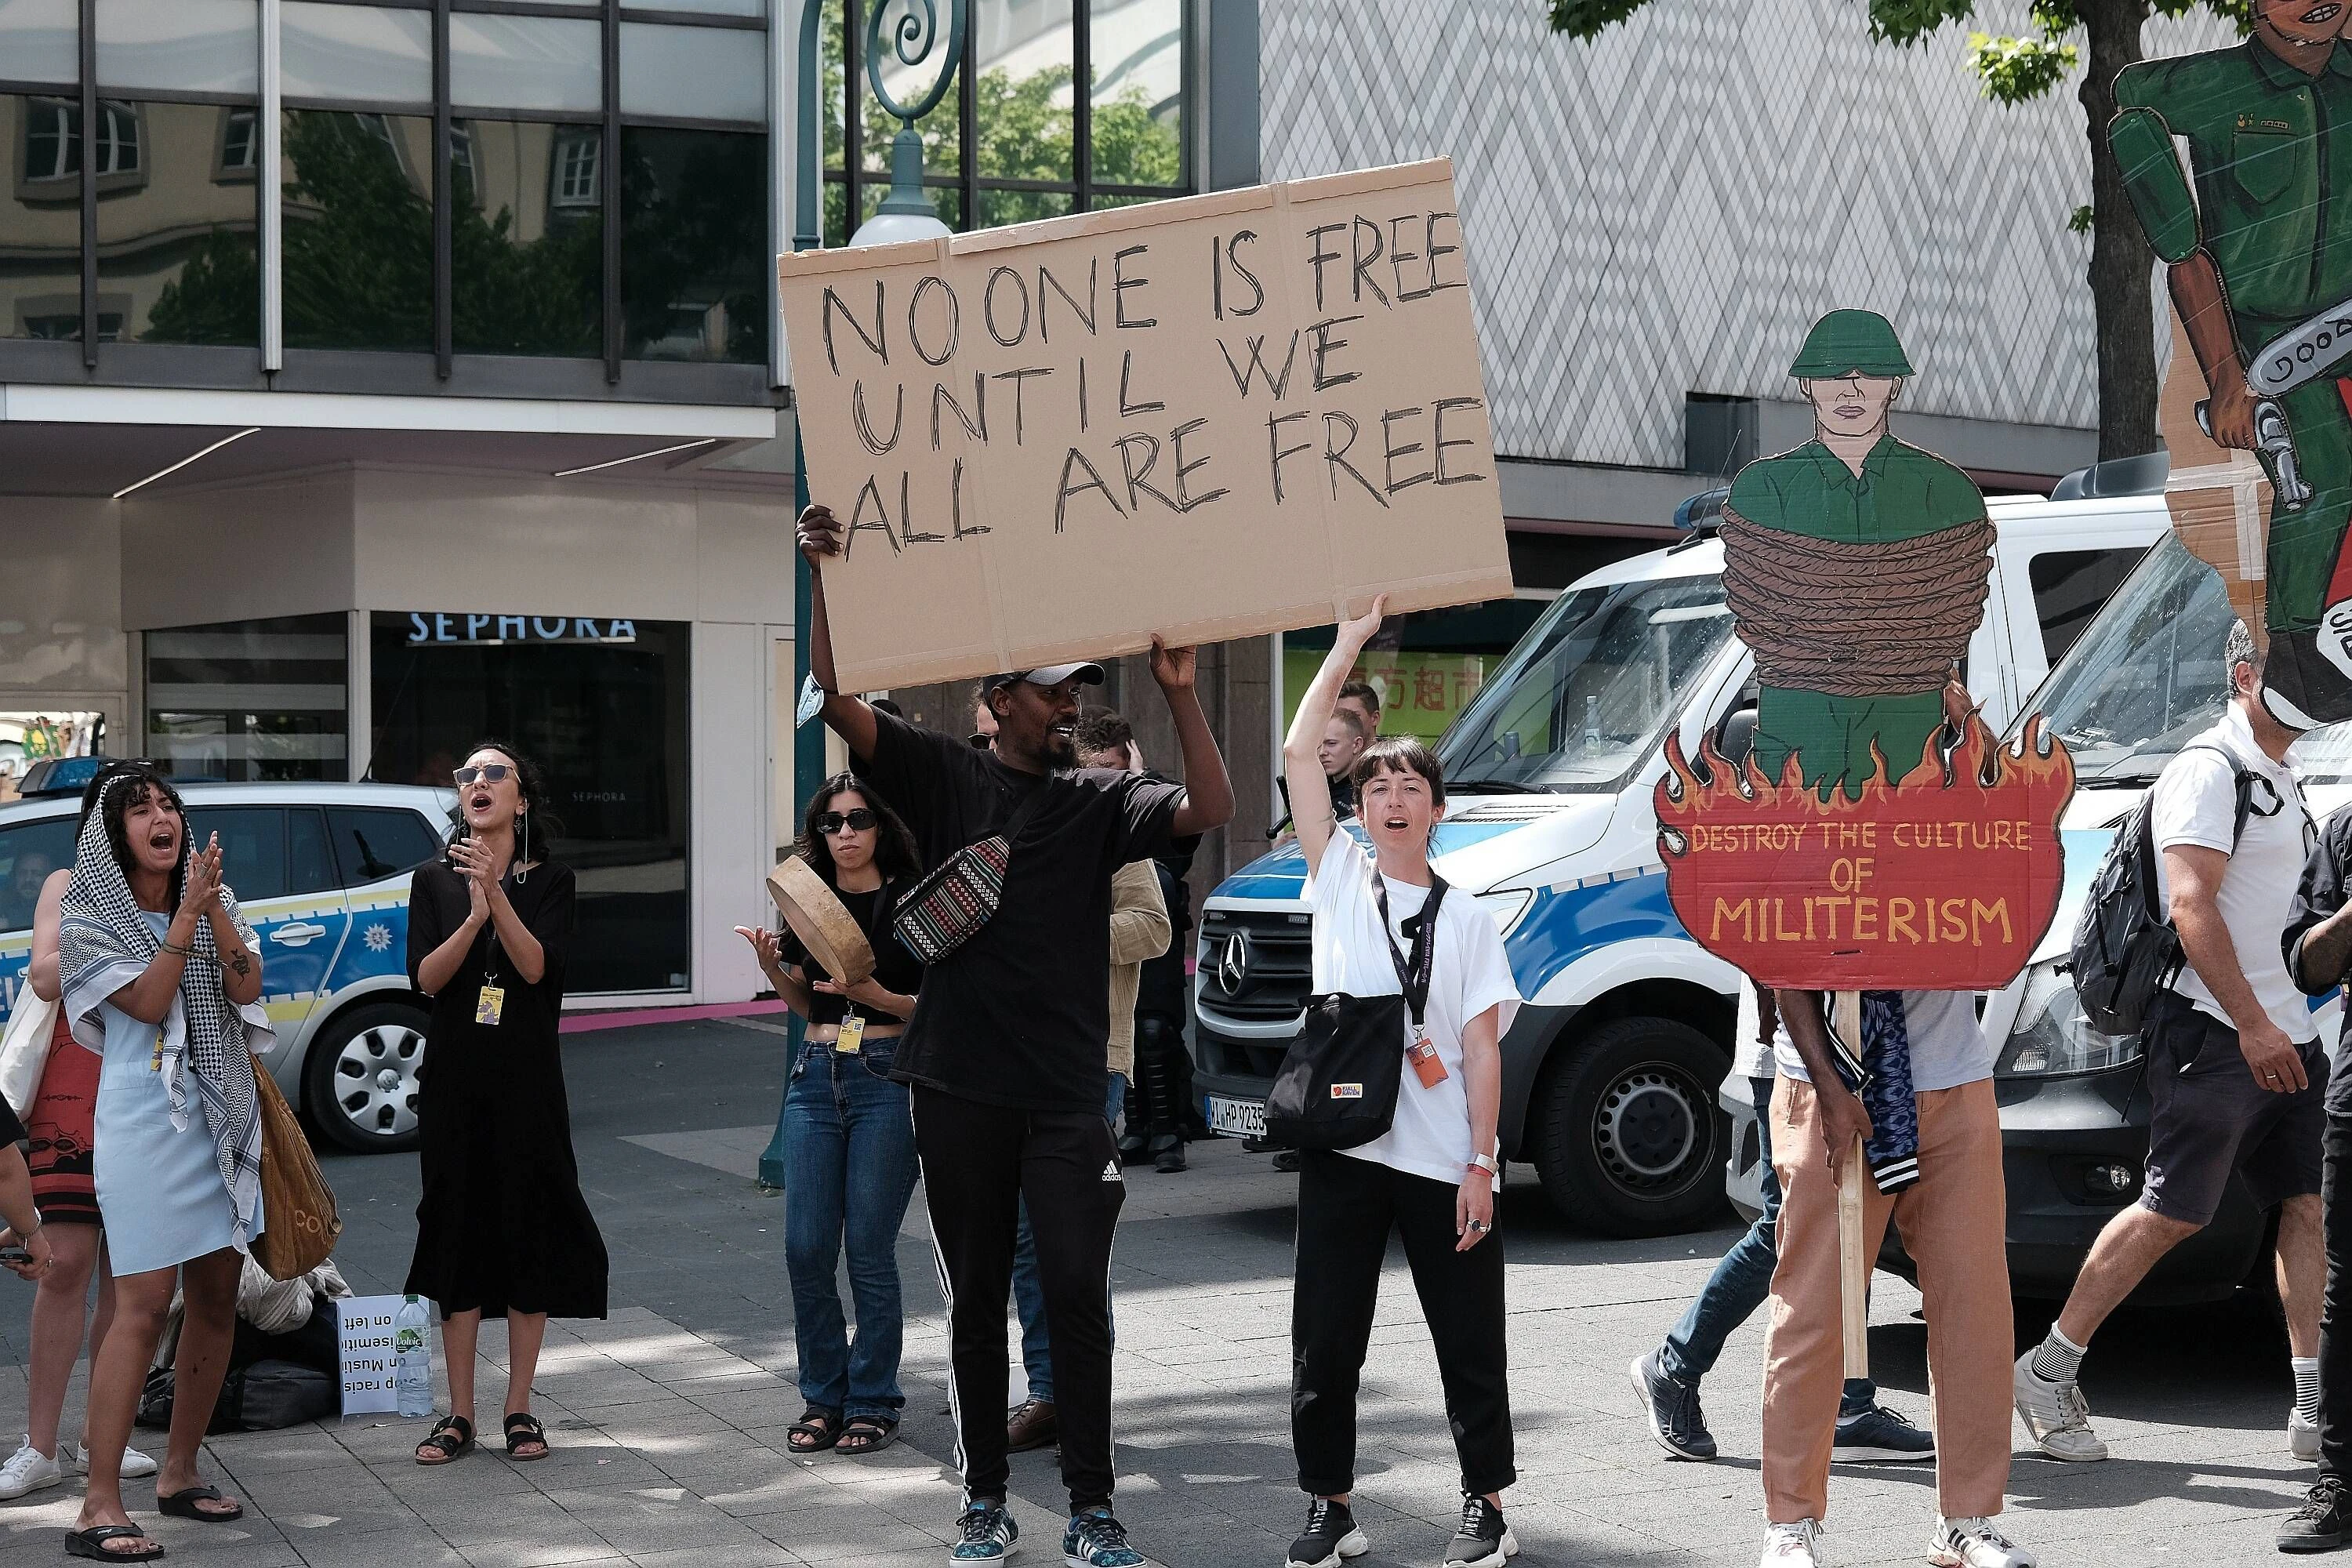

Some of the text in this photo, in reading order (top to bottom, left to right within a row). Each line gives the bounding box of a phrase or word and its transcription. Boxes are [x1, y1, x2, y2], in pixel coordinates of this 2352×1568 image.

[822, 211, 1468, 376] NO ONE IS FREE
[853, 314, 1364, 456] UNTIL WE
[844, 397, 1487, 563] ALL ARE FREE
[1692, 820, 2033, 853] DESTROY THE CULTURE
[1829, 857, 1875, 894] OF
[1711, 895, 2013, 946] MILITERISM
[1225, 1102, 1236, 1128] HP
[1239, 1105, 1265, 1131] 9235
[344, 1316, 391, 1330] on left
[342, 1337, 394, 1352] isemiti
[397, 1336, 421, 1346] Volvic
[342, 1359, 383, 1374] Musli
